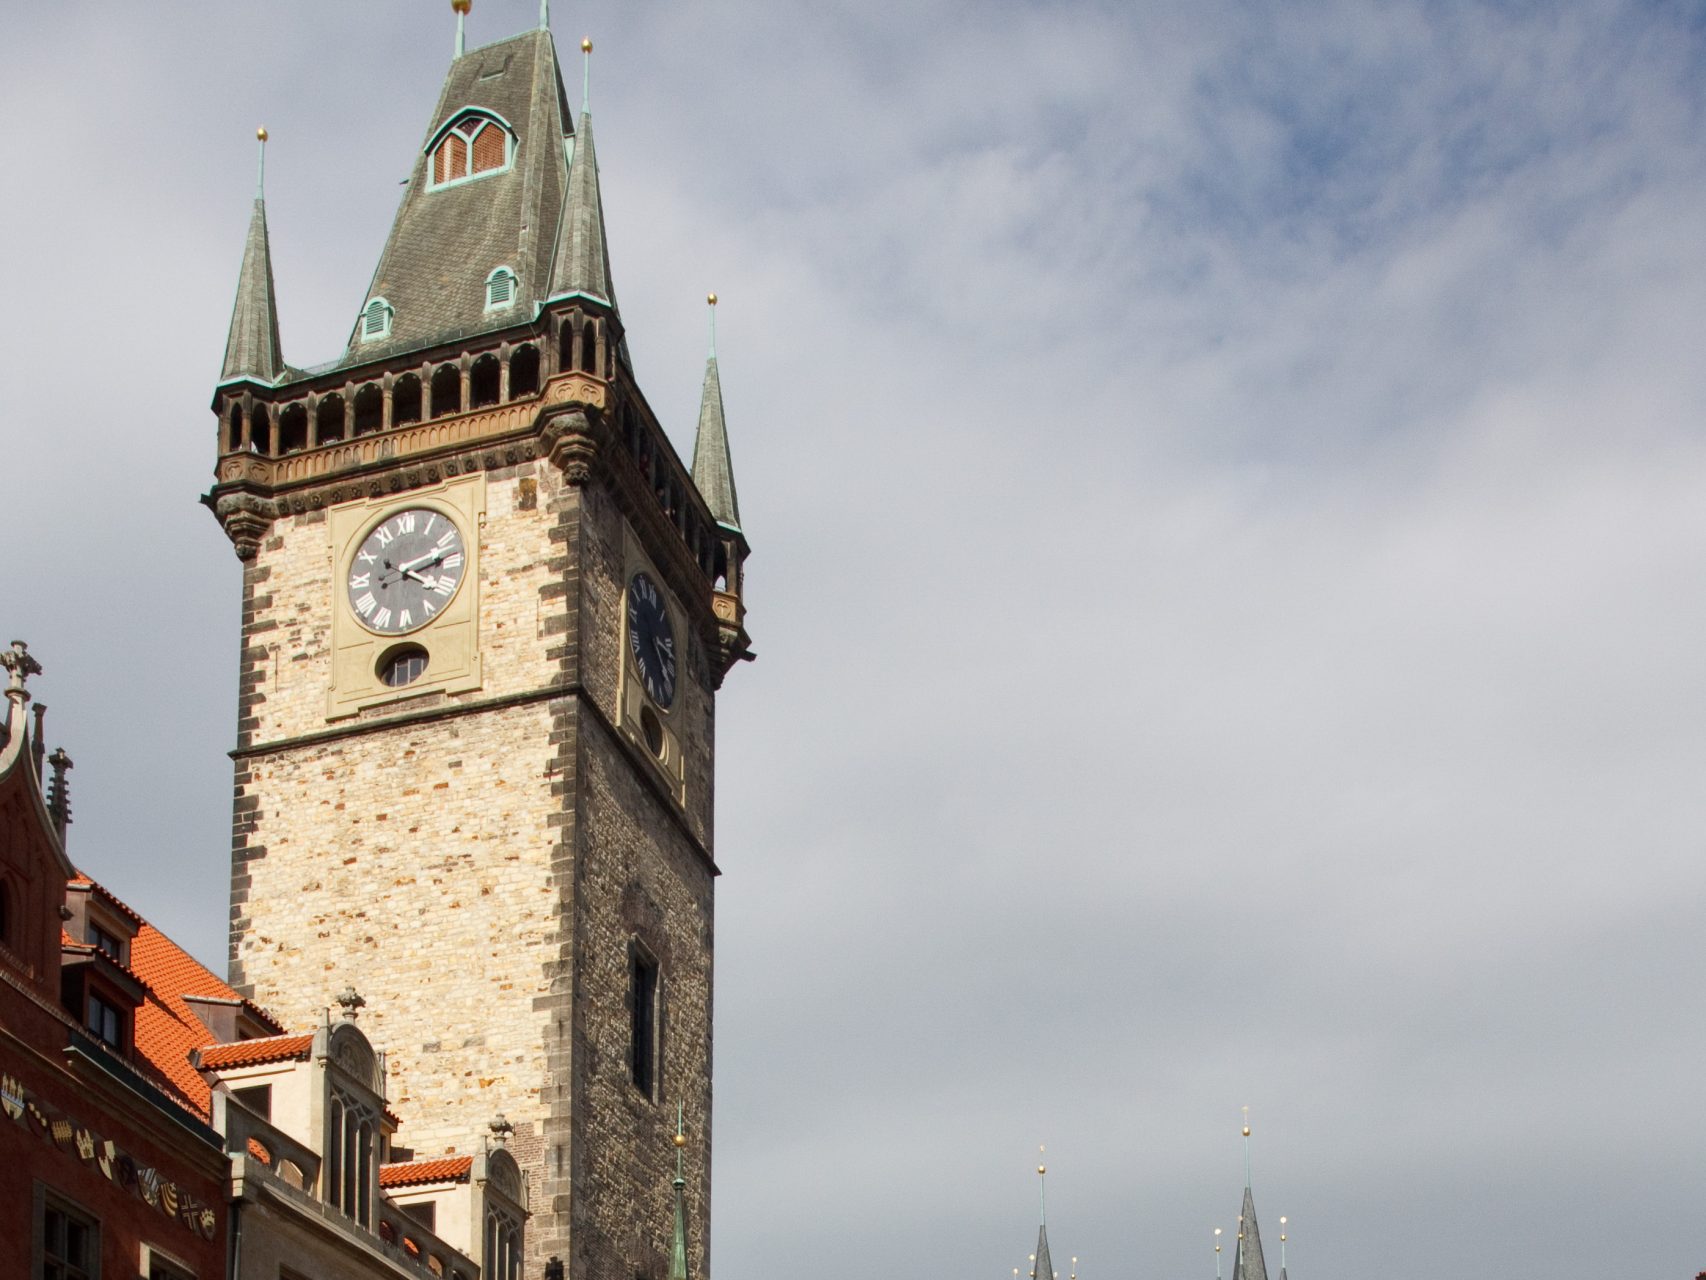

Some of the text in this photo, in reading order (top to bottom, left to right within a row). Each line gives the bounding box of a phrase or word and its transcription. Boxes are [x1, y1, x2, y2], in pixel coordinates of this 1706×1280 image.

[396, 515, 415, 536] XII
[375, 526, 394, 549] XI
[437, 530, 455, 546] II
[358, 550, 377, 565] X
[443, 552, 461, 569] III
[352, 572, 370, 589] IX
[355, 591, 377, 618] VIII
[423, 600, 436, 616] V
[372, 606, 392, 628] VII
[399, 609, 412, 628] VI
